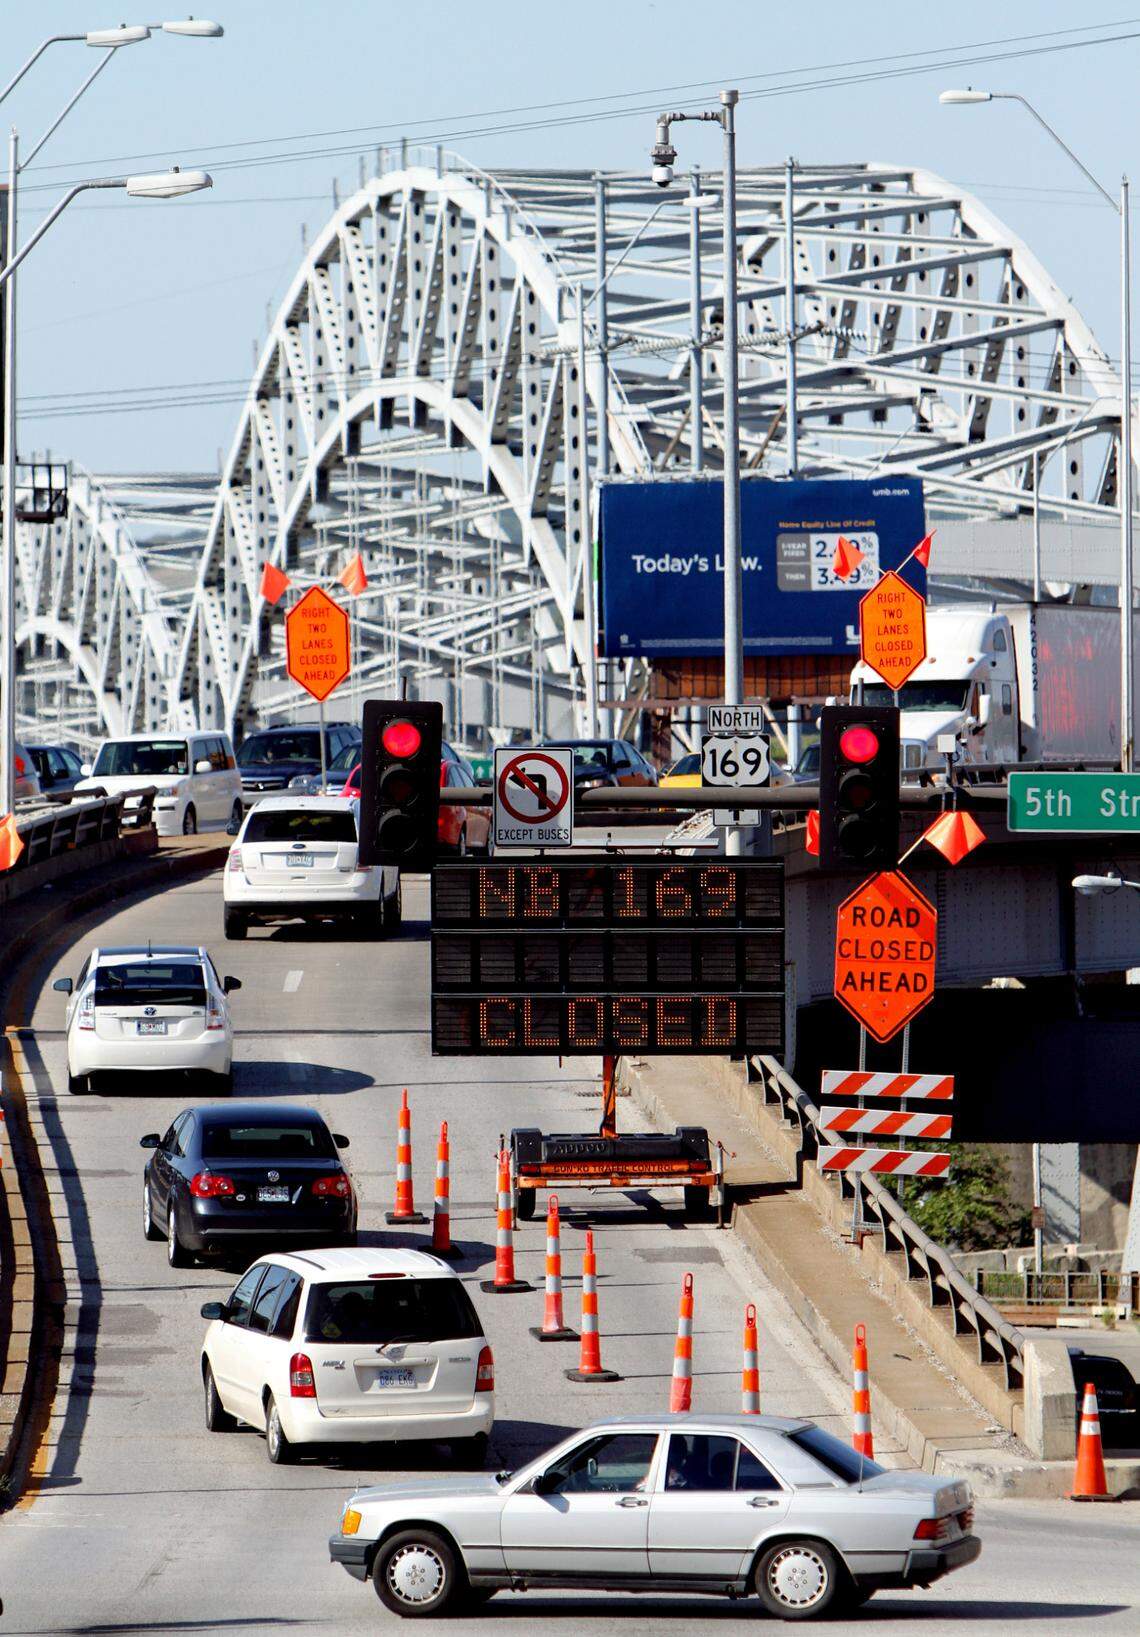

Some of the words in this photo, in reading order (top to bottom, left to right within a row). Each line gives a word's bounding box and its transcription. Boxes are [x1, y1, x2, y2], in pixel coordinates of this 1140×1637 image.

[872, 487, 910, 497] umb.com
[632, 553, 708, 575] Today's
[715, 553, 762, 572] Lw.
[877, 592, 906, 604] RIGHT
[301, 608, 330, 618] RIGHT
[883, 608, 903, 619] TWO
[308, 624, 327, 634] TWO
[877, 624, 909, 636] LANES
[302, 639, 333, 649] LANES
[874, 640, 914, 652] CLOSED
[1030, 614, 1038, 691] 42032
[300, 655, 337, 665] CLOSED
[878, 656, 912, 668] AHEAD
[304, 670, 336, 681] AHEAD
[712, 709, 760, 728] NORTH
[709, 747, 762, 778] 169
[1025, 787, 1072, 817] 5th
[497, 828, 534, 841] EXCEPT
[538, 828, 570, 841] BUSES
[479, 866, 560, 917] NB
[618, 866, 737, 918] 169
[852, 906, 921, 929] ROAD
[838, 938, 934, 962] CLOSED
[841, 970, 928, 993] AHEAD
[479, 995, 738, 1047] CLOSED
[592, 1165, 631, 1174] TRAFFIC
[633, 1164, 674, 1173] CONTROL
